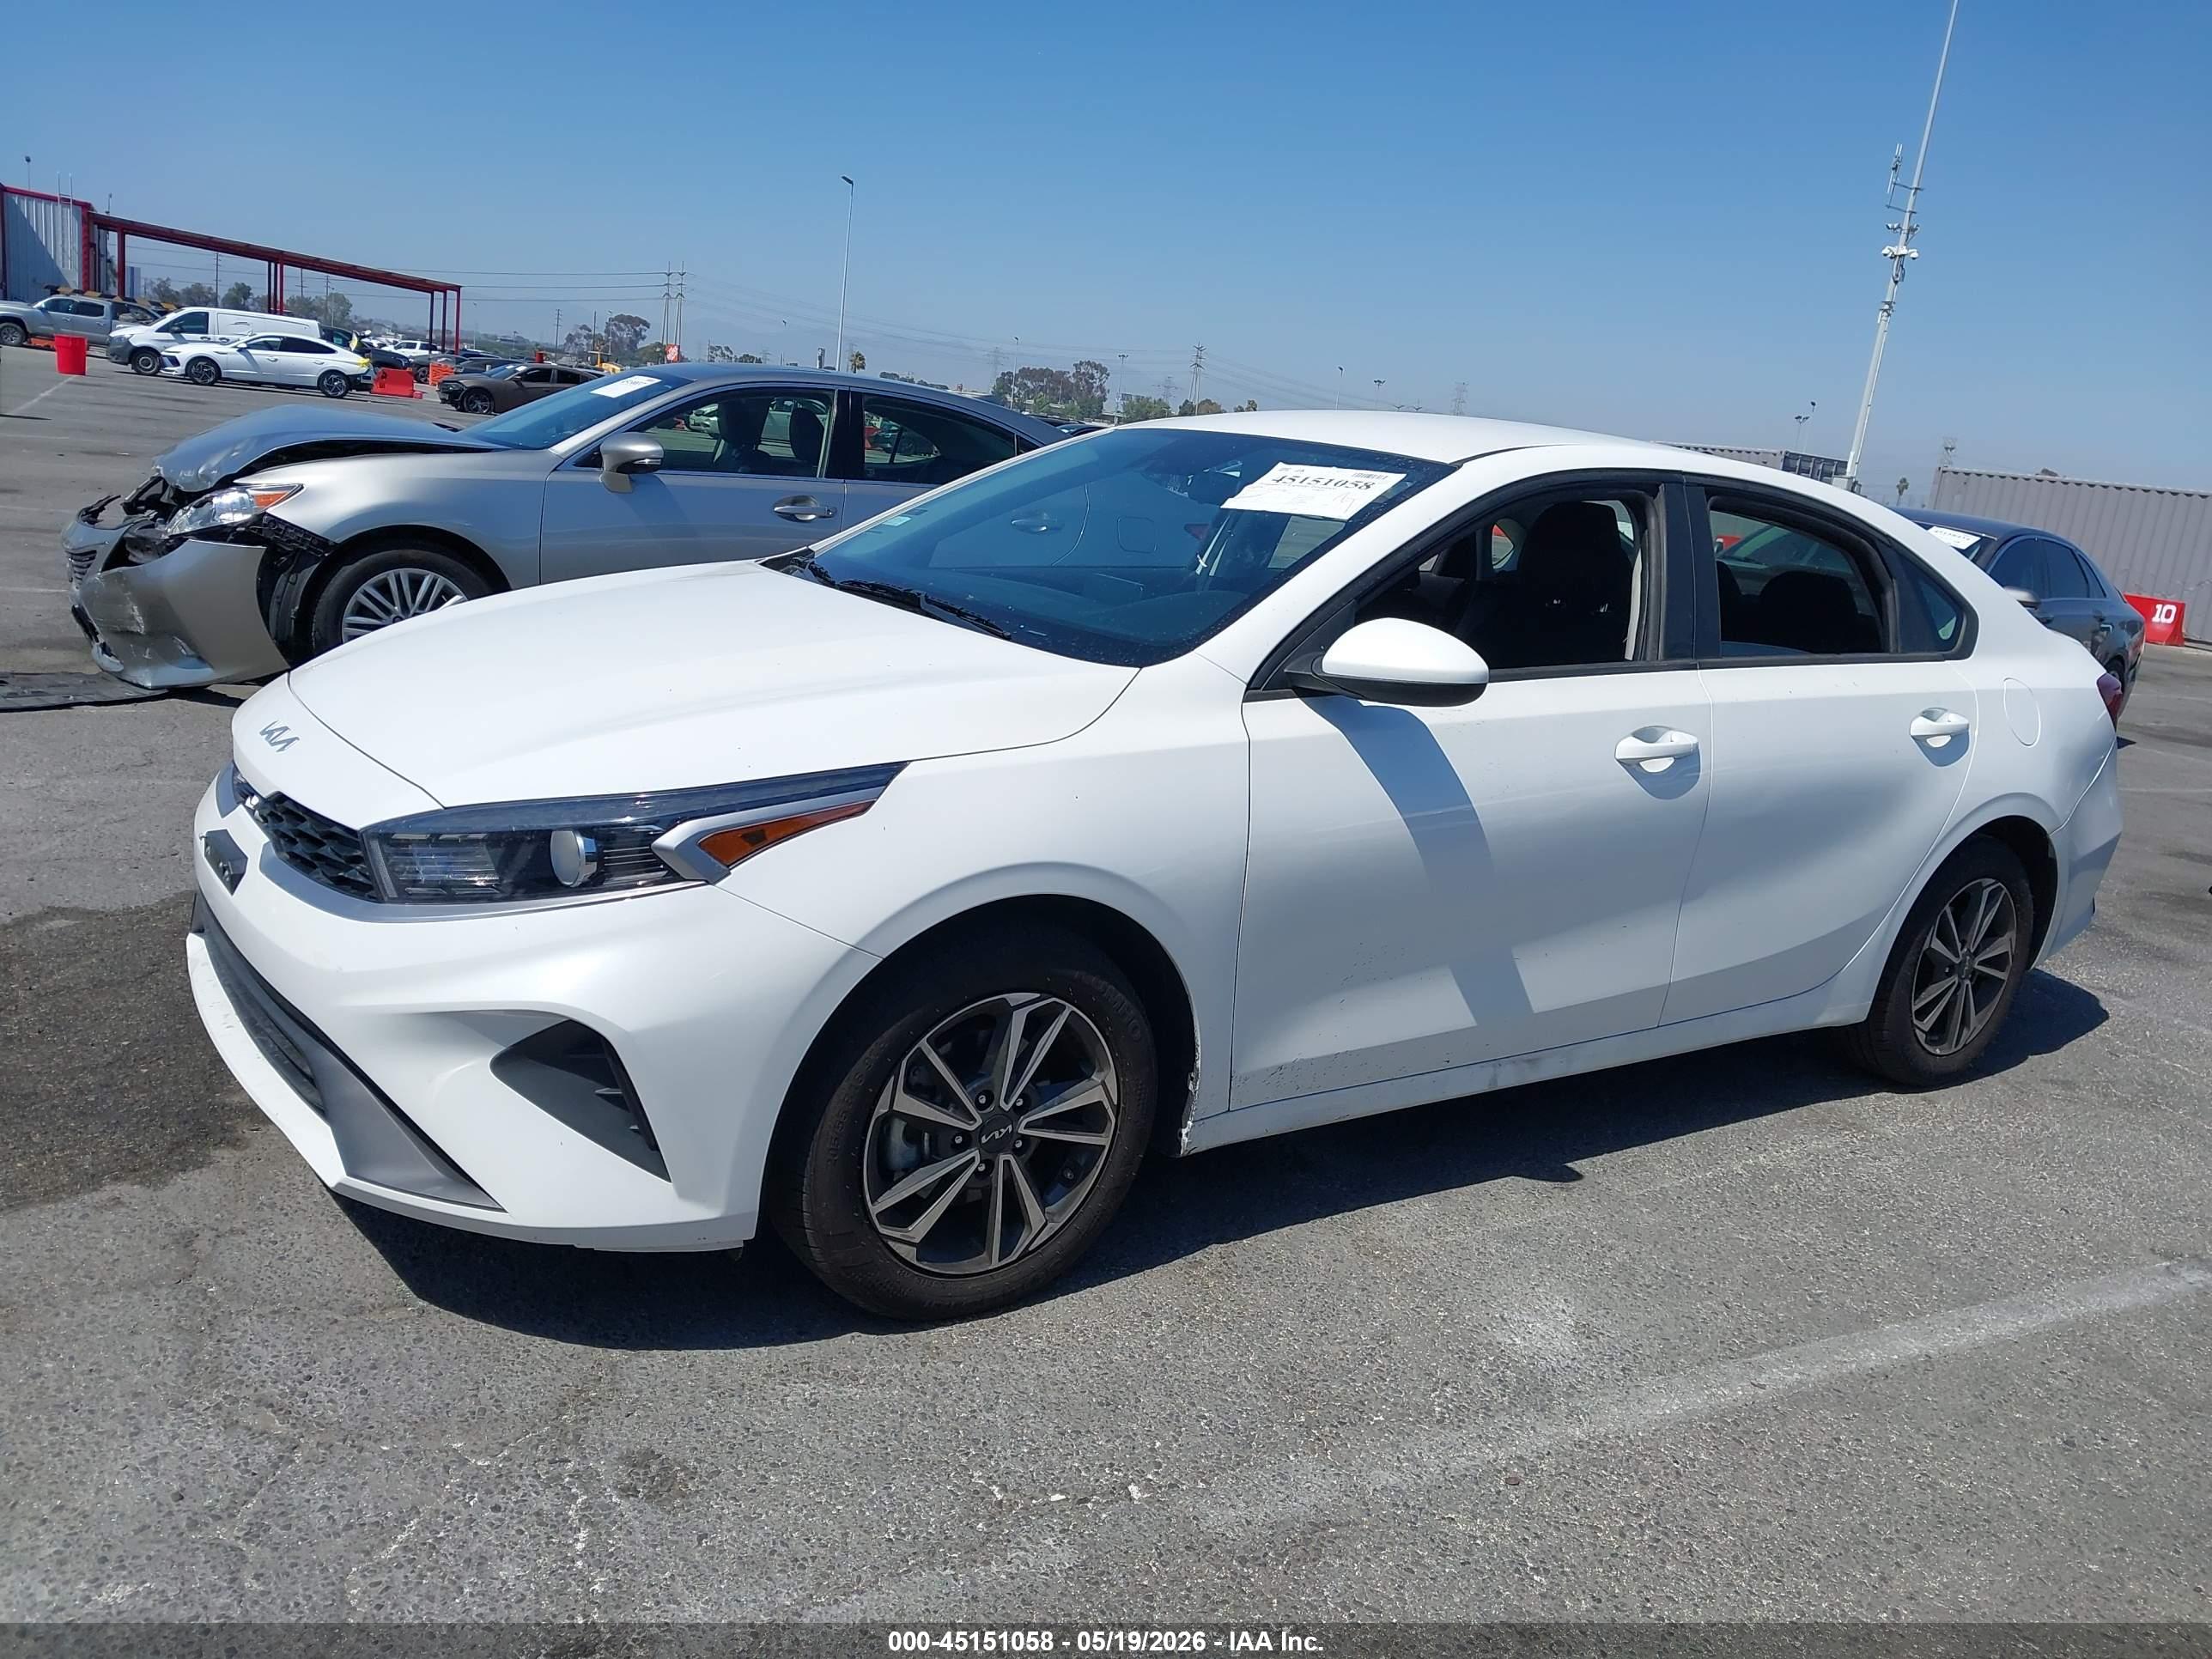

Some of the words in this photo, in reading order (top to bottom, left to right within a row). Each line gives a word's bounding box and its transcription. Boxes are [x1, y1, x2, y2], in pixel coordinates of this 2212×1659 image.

[1272, 475, 1376, 490] 45151058
[2152, 604, 2177, 624] 10
[259, 720, 300, 752] KIA
